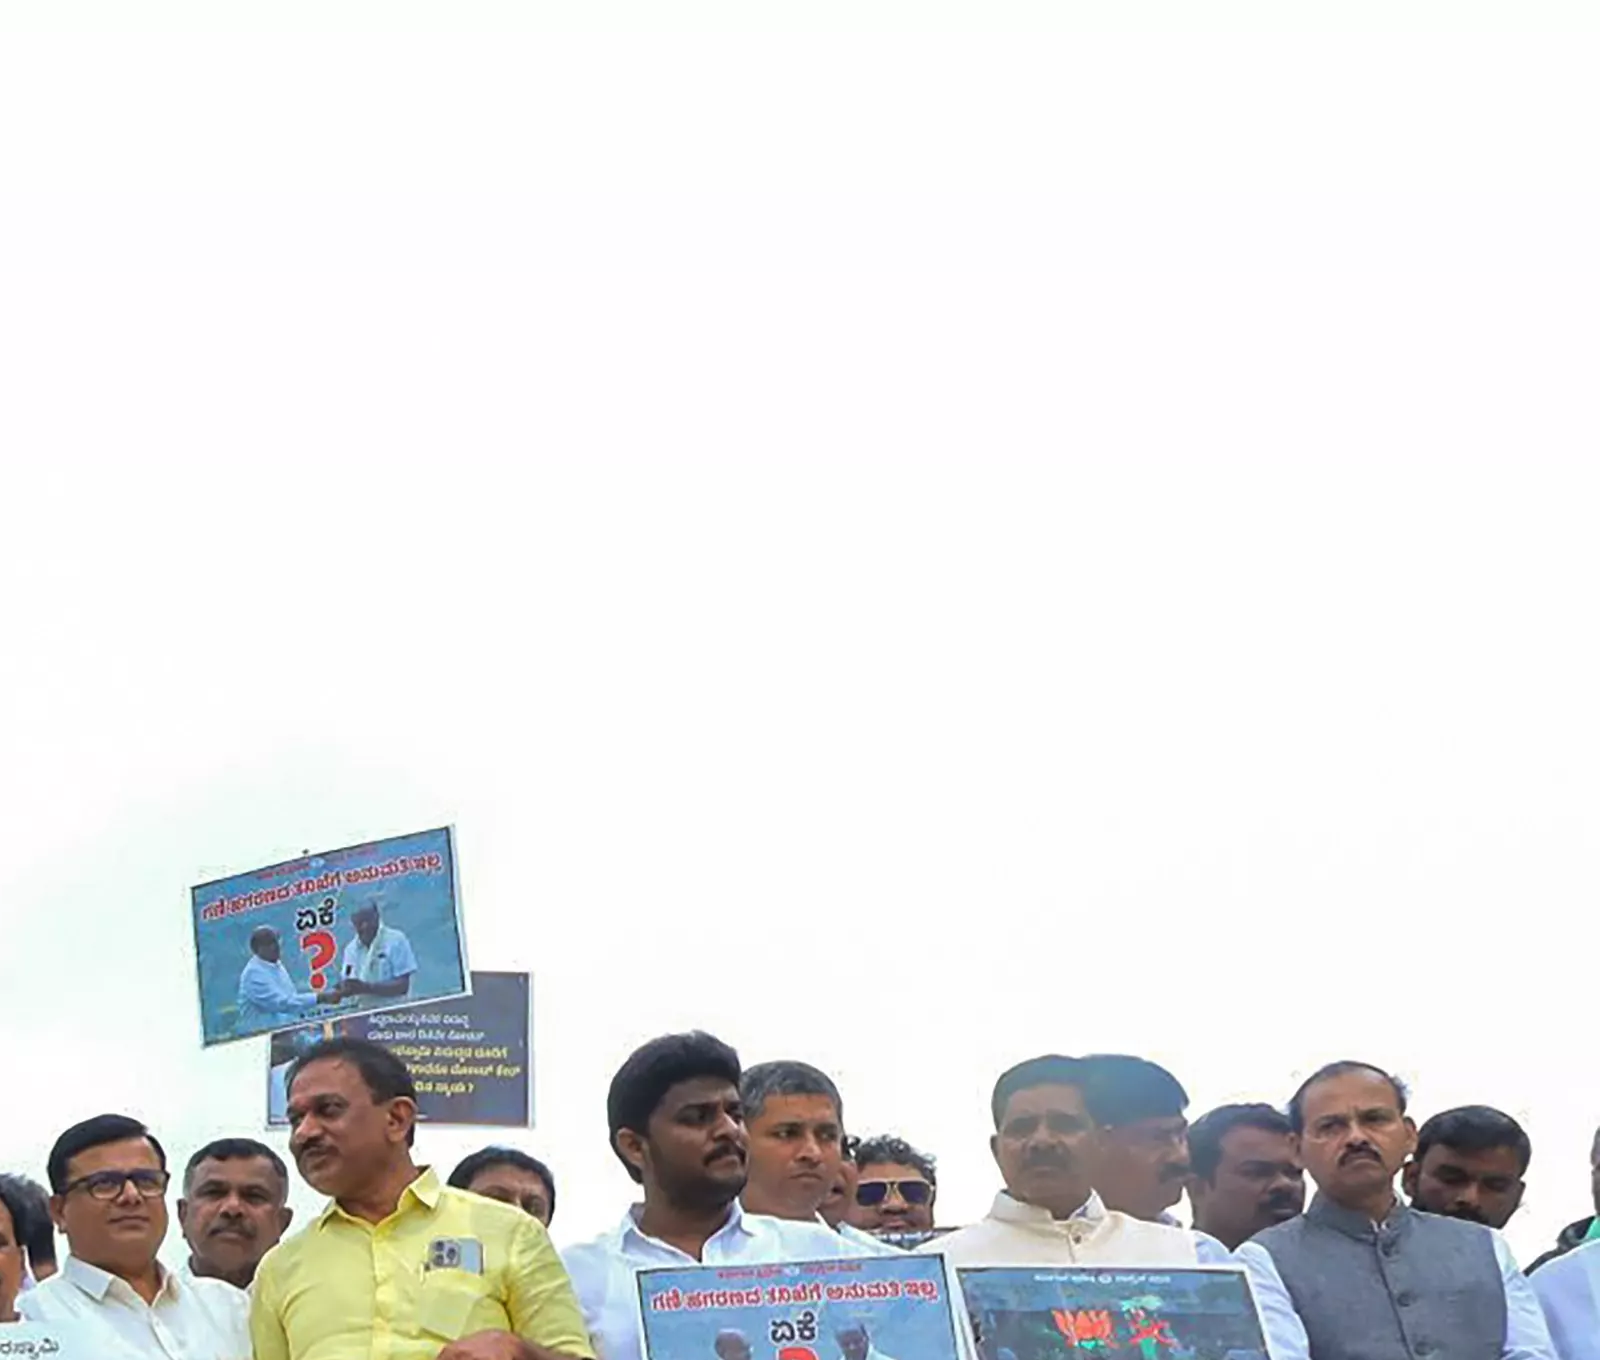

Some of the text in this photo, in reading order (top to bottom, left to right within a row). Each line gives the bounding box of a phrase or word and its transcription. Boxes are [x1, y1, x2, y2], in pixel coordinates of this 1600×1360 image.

[296, 897, 336, 931] ಏಕೆ
[303, 932, 338, 990] ?
[652, 1289, 681, 1311] ಗಣಿ
[827, 1280, 901, 1301] ಅನುಮತಿ
[770, 1311, 817, 1344] ಏಕೆ
